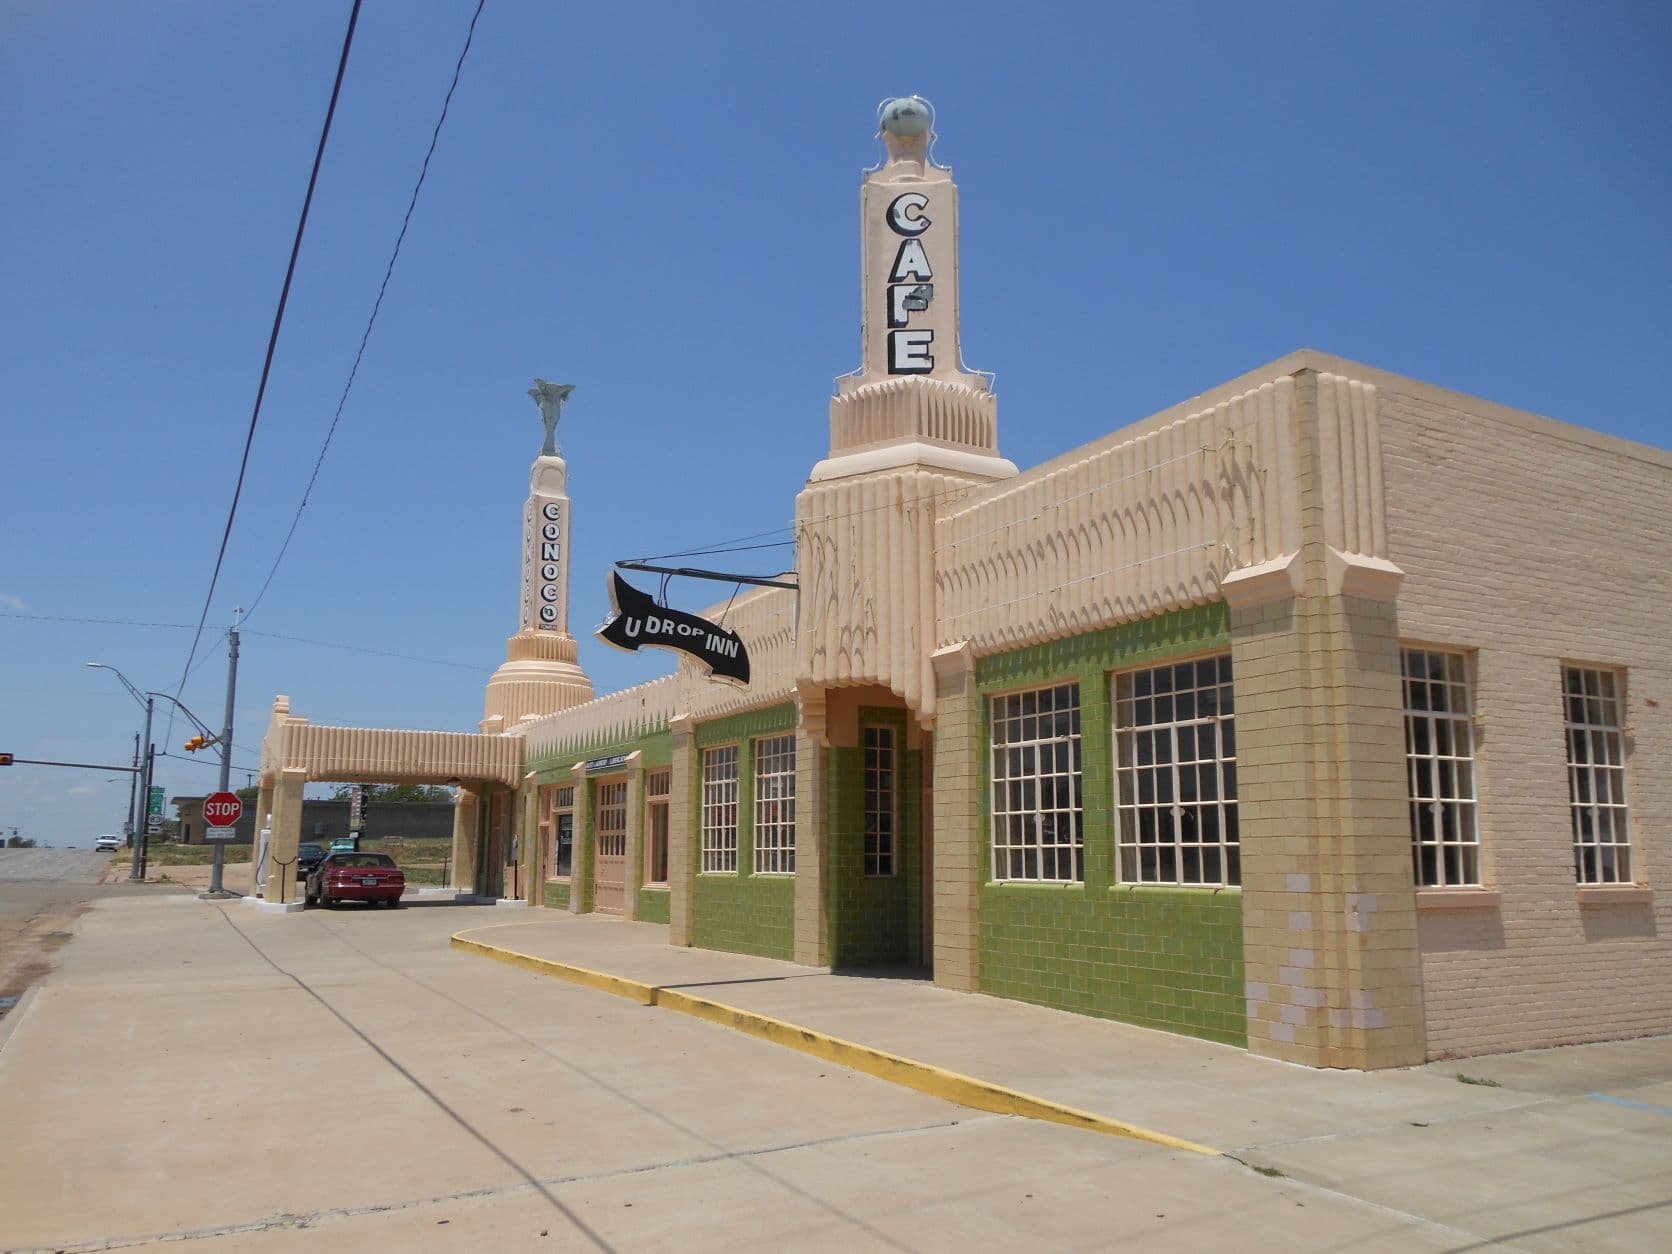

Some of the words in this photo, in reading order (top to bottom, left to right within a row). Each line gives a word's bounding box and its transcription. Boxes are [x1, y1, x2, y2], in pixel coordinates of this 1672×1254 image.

[886, 192, 934, 375] CAFE
[540, 502, 561, 623] CONOCO
[624, 616, 642, 638] U
[645, 615, 705, 637] DROP
[705, 633, 739, 659] INN
[206, 802, 240, 816] STOP
